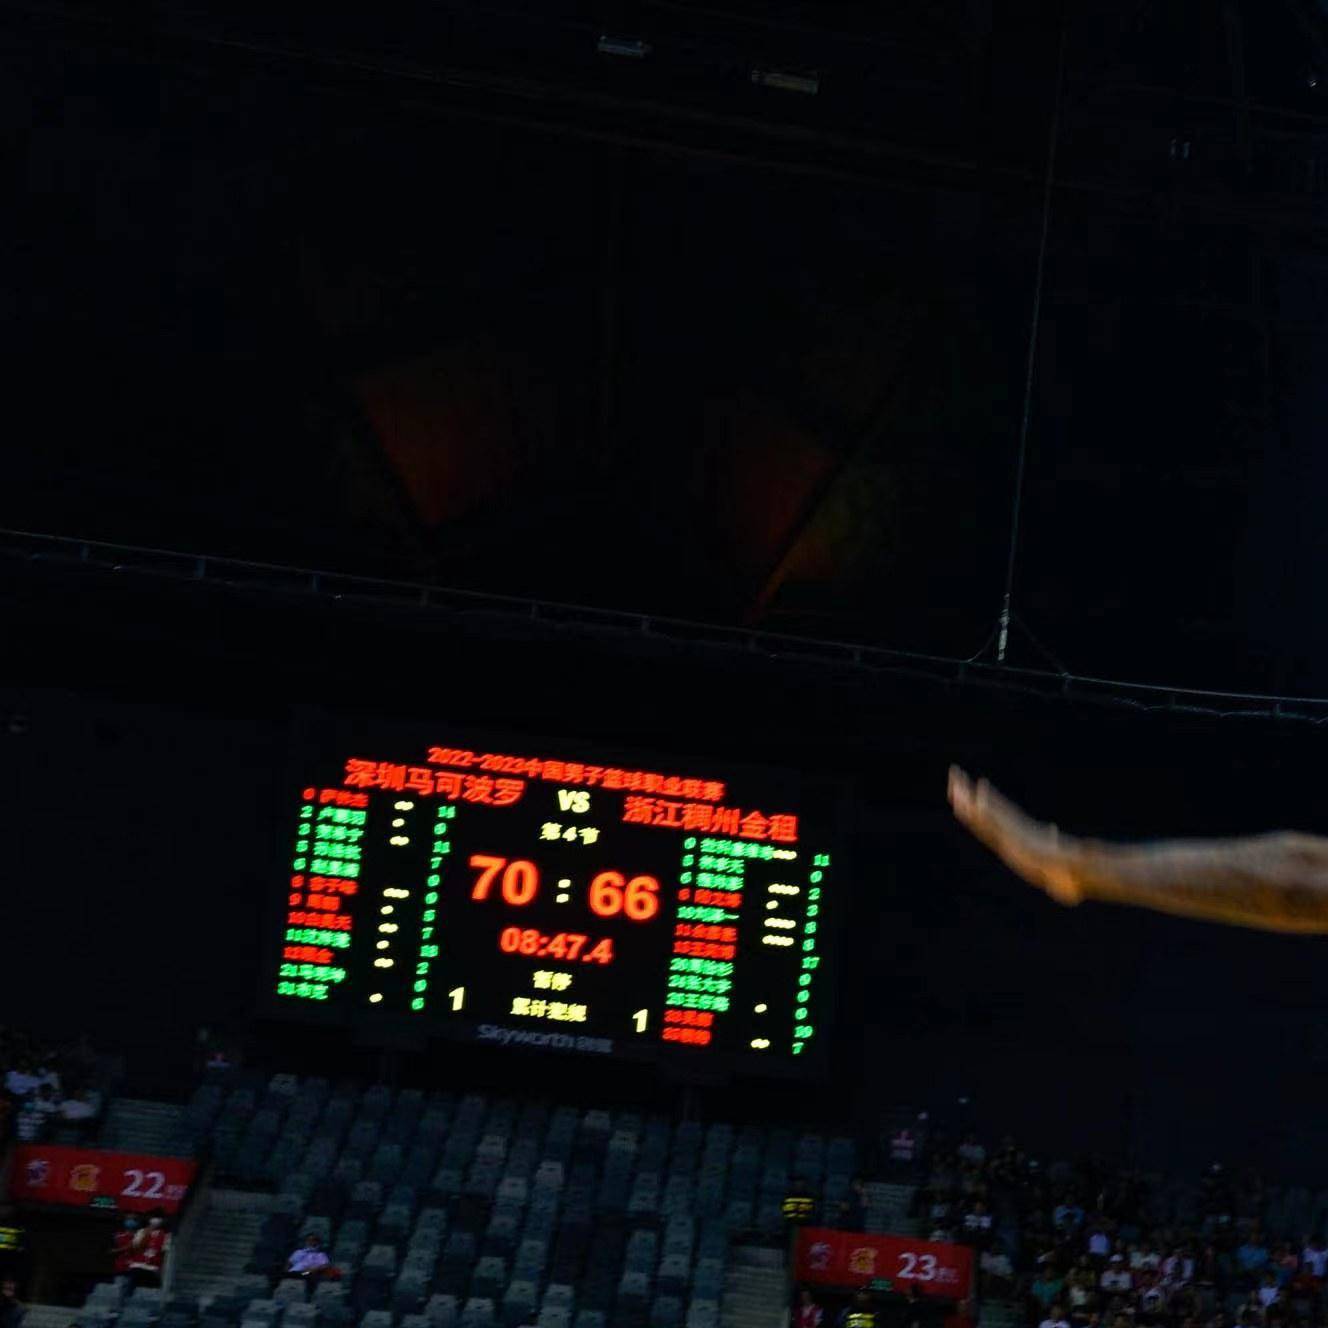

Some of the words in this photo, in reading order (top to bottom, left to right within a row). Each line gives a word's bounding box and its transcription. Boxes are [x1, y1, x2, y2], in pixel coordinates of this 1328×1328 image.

[343, 758, 526, 807] 深圳马可波罗
[557, 788, 591, 813] VS
[621, 796, 799, 842] 浙江稠州金租
[469, 854, 540, 905] 70
[588, 871, 660, 919] 66
[500, 926, 614, 965] 08:47.4
[448, 986, 465, 1011] 1
[632, 1008, 649, 1033] 1
